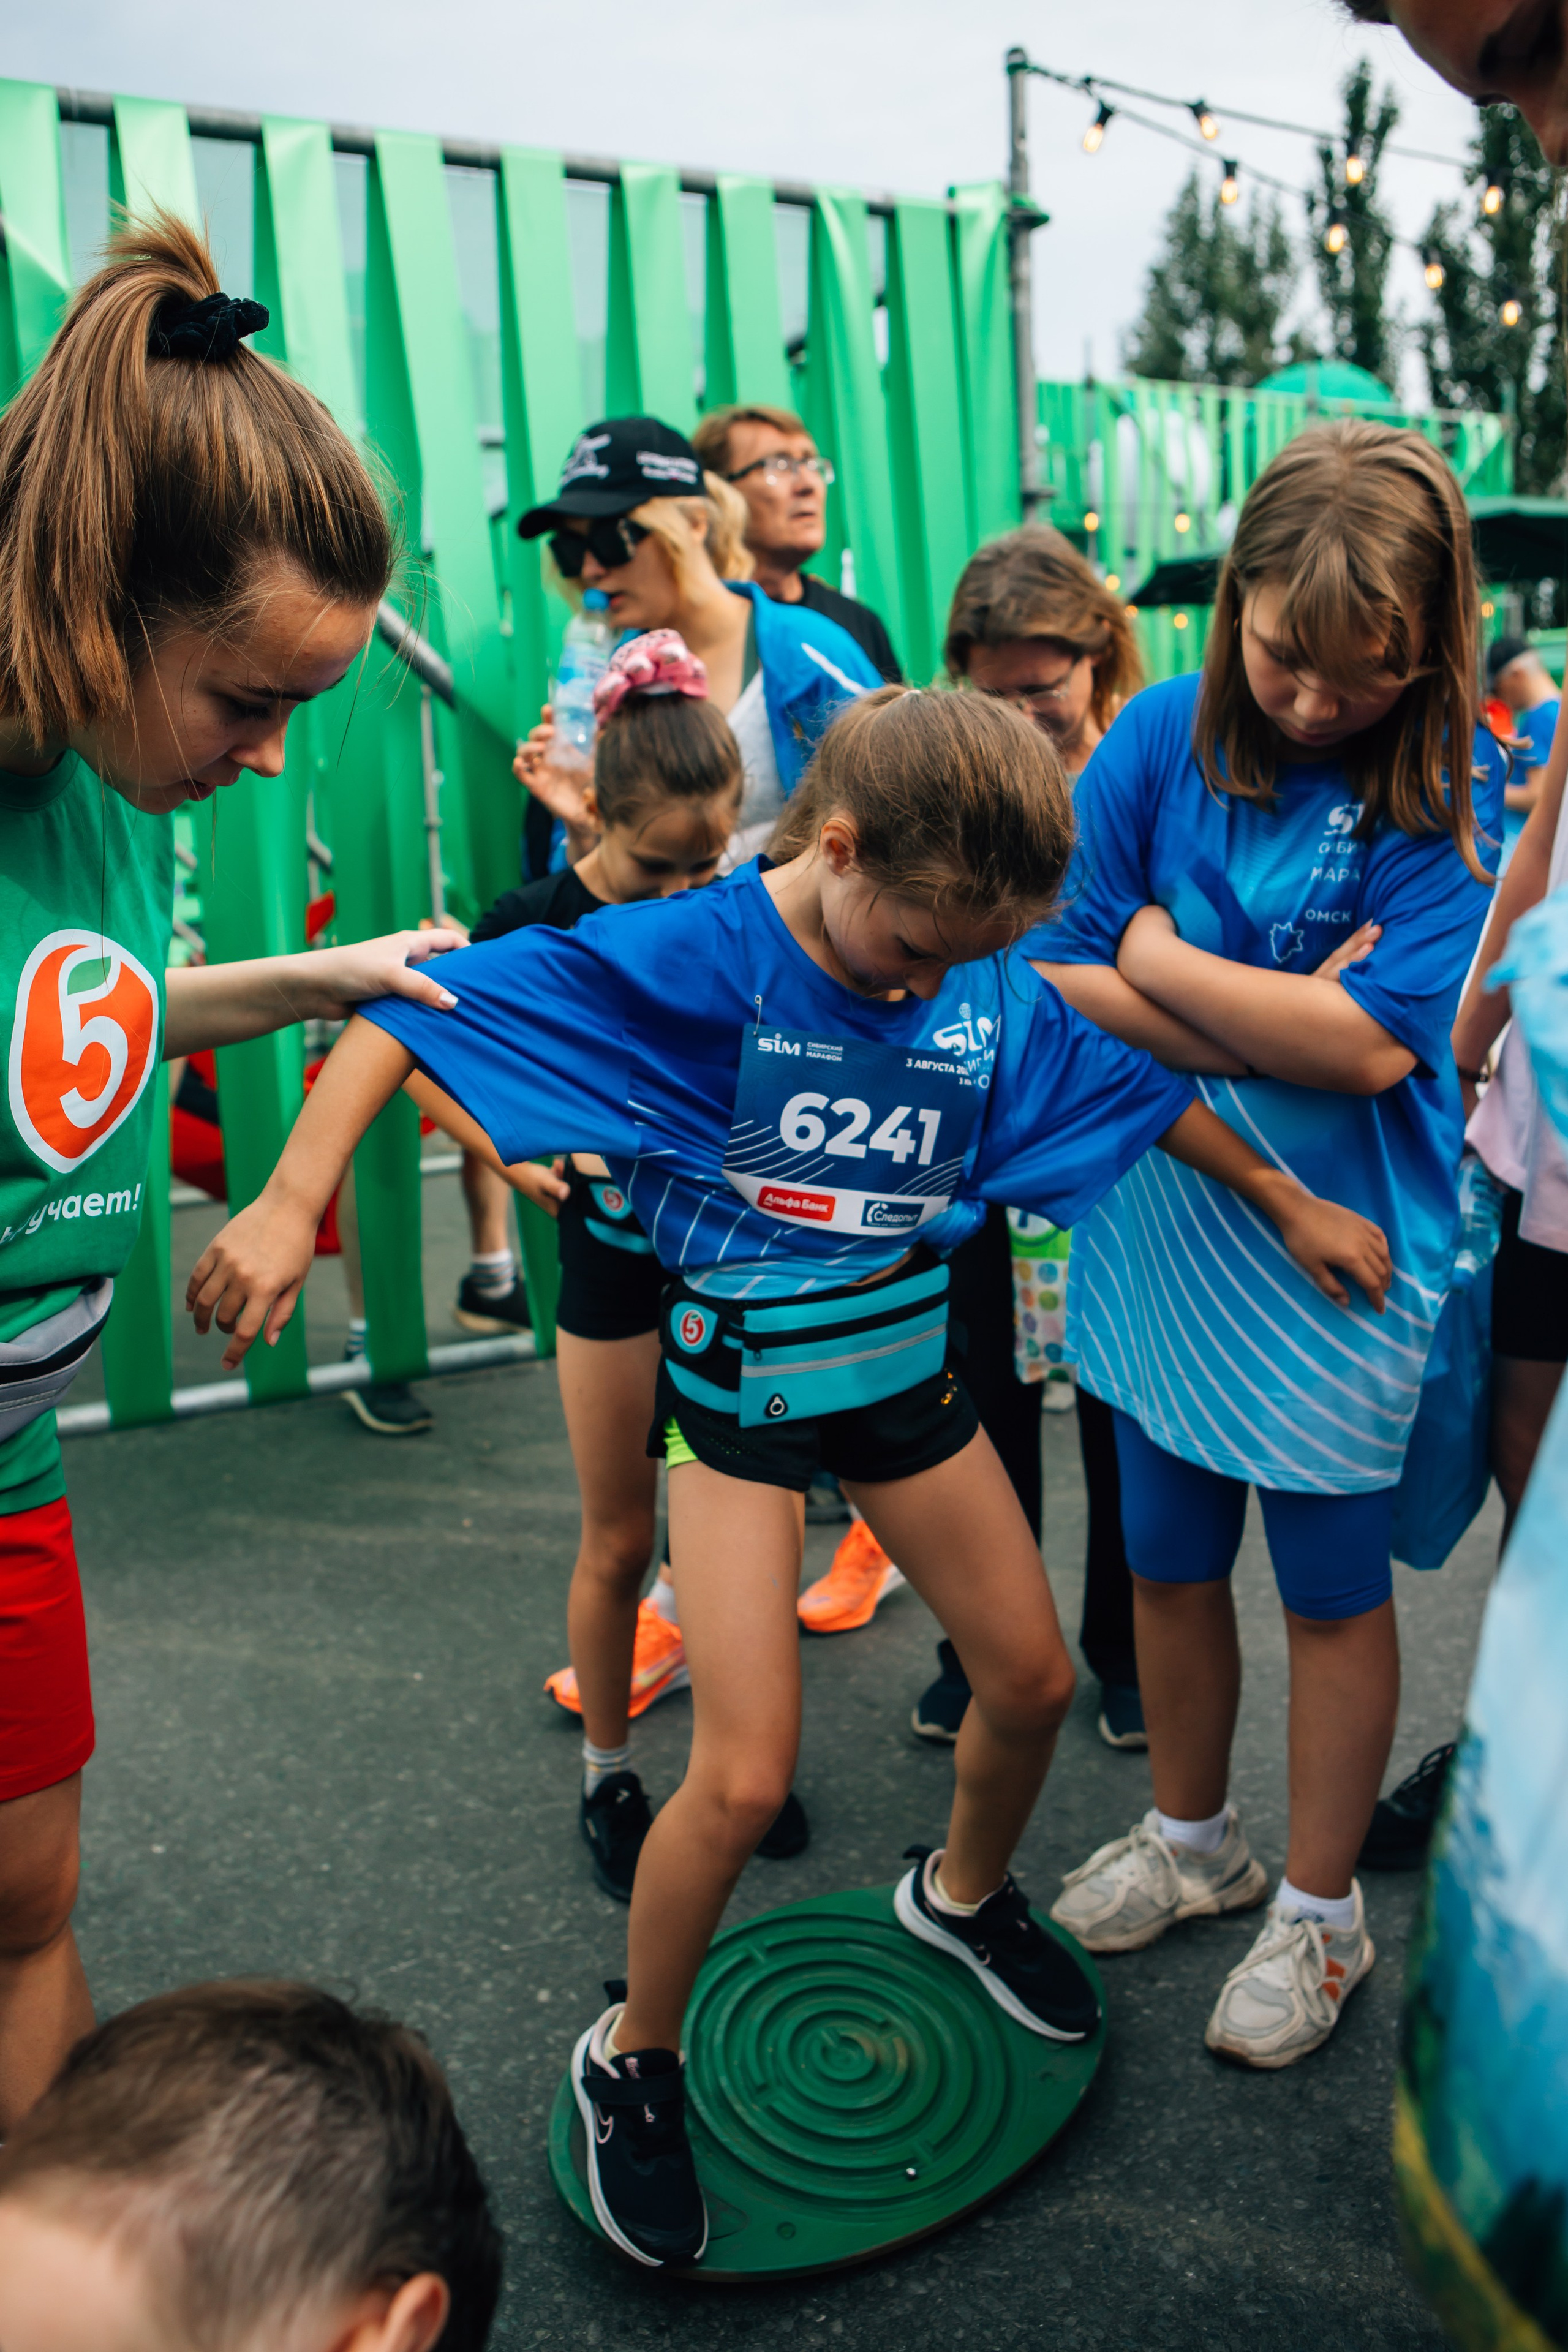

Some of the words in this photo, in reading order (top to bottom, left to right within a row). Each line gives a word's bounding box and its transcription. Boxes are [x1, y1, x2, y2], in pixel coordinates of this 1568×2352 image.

[1305, 909, 1351, 922] ОМСК
[805, 1050, 842, 1062] МАРАФОН
[906, 1058, 913, 1068] 3
[913, 1059, 955, 1073] АВГУСТА
[780, 1092, 941, 1166] 6241
[763, 1193, 801, 1209] Альфа
[801, 1198, 829, 1213] Банк
[873, 1210, 918, 1223] Следопыт
